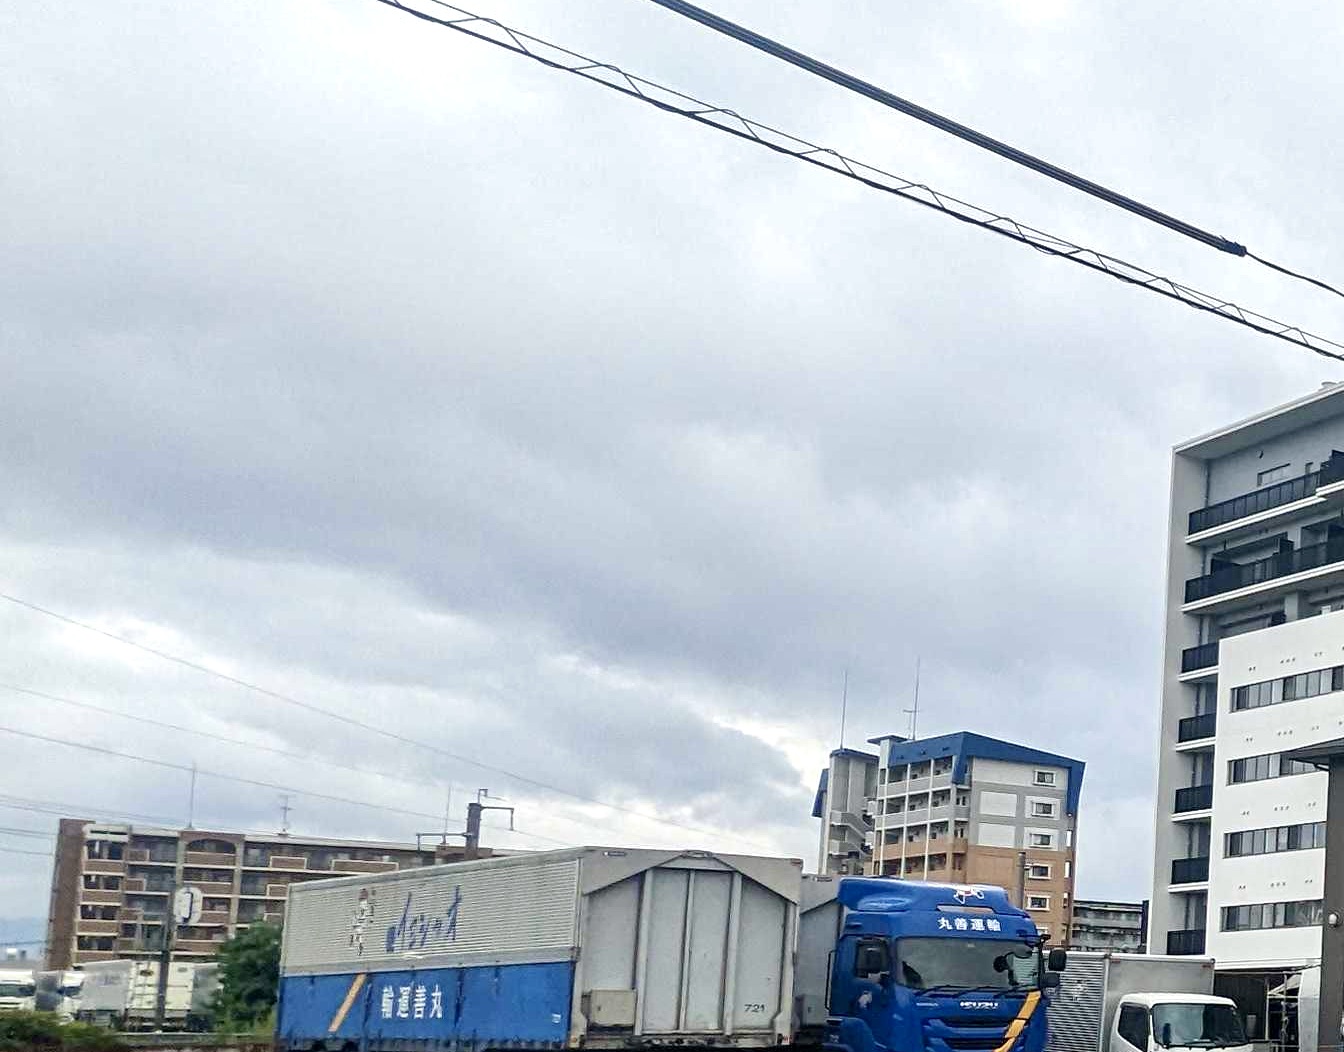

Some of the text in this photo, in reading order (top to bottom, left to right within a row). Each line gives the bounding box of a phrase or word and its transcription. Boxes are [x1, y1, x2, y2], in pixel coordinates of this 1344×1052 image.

[937, 917, 1001, 932] 丸善運輸
[744, 1003, 765, 1013] 721
